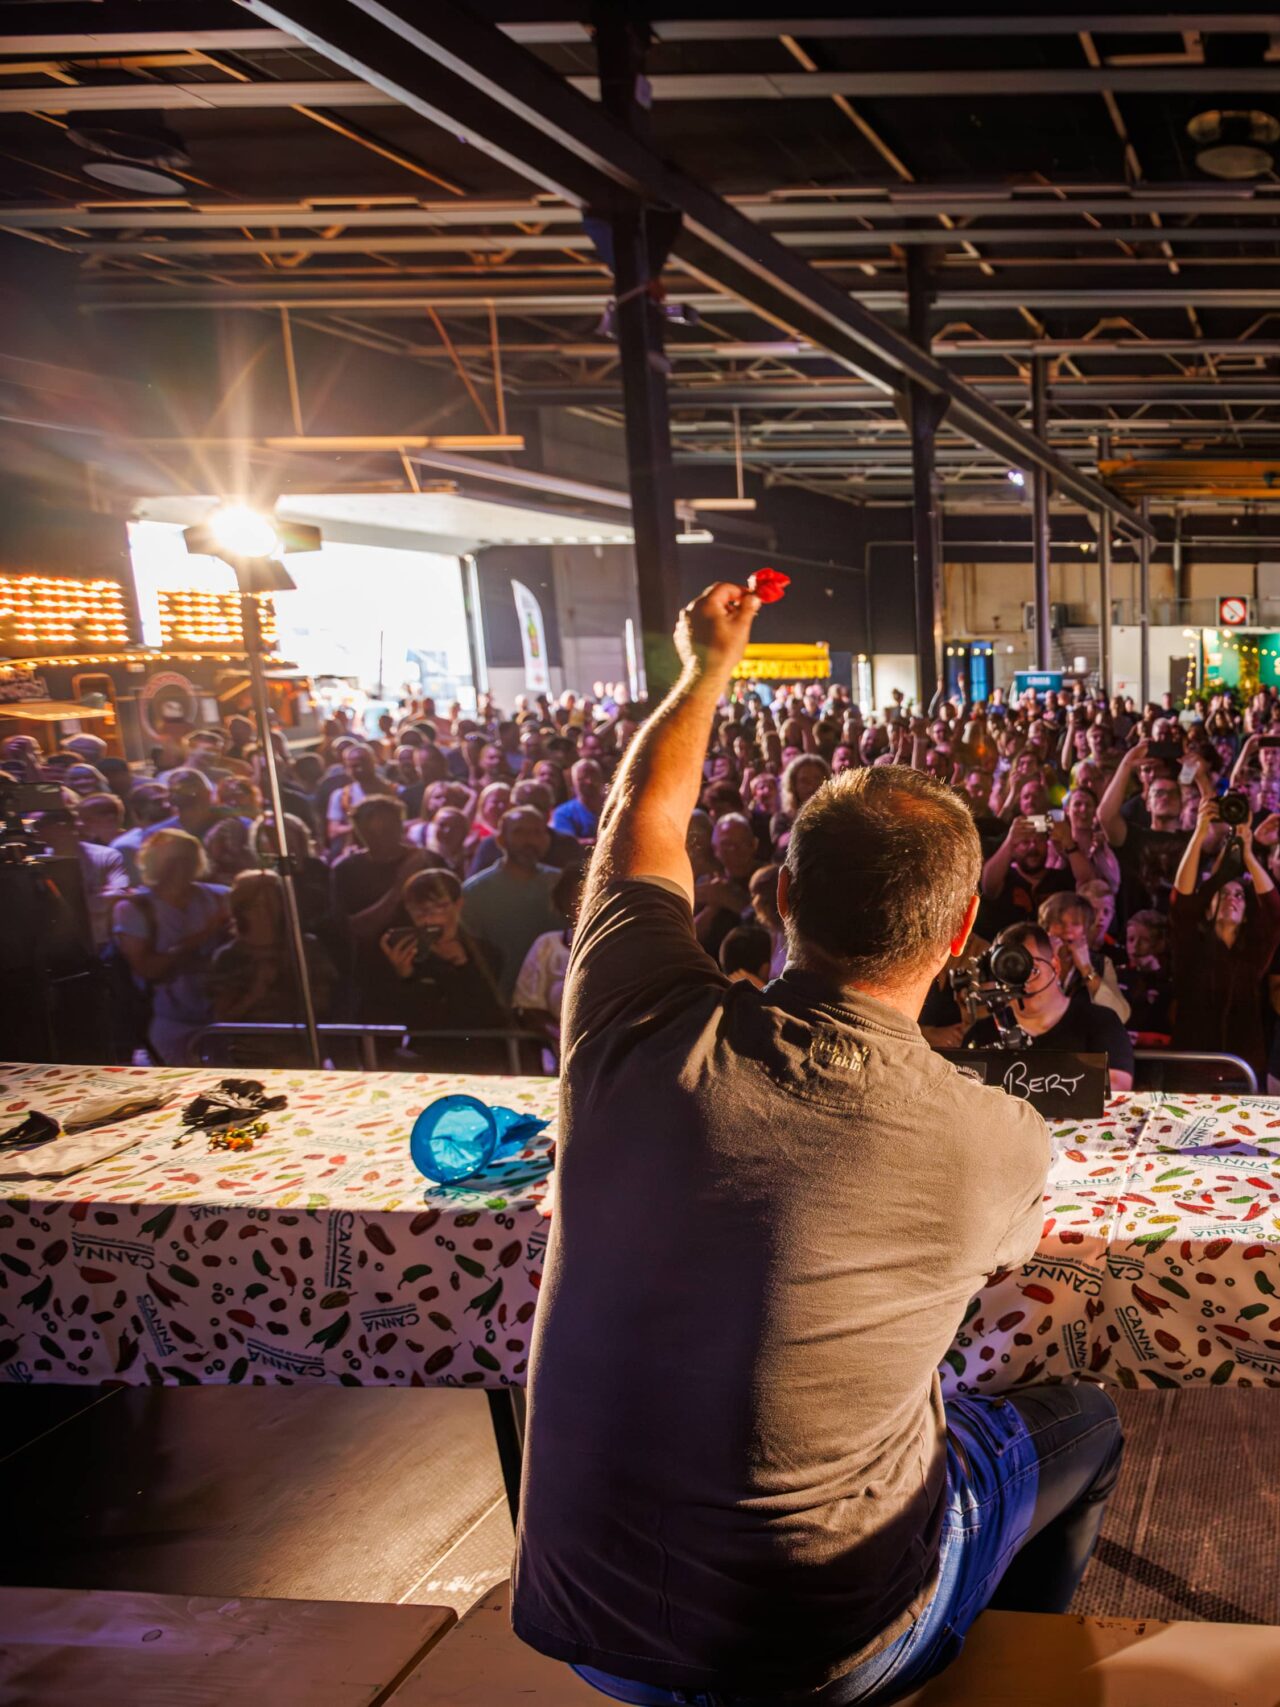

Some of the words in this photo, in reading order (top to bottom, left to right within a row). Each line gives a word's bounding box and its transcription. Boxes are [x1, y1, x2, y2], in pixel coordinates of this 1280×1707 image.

[1003, 1062, 1085, 1100] BERT
[1193, 1154, 1270, 1169] CANNA
[1191, 1226, 1264, 1238] CANNA
[73, 1242, 155, 1270] CANNA
[337, 1212, 354, 1289] CANNA
[1020, 1263, 1101, 1296] CANNA
[1107, 1264, 1143, 1280] CA
[144, 1294, 177, 1354] CANNA
[363, 1312, 420, 1333] CANNA
[1125, 1305, 1159, 1361] CANNA
[247, 1350, 326, 1377] CANNA
